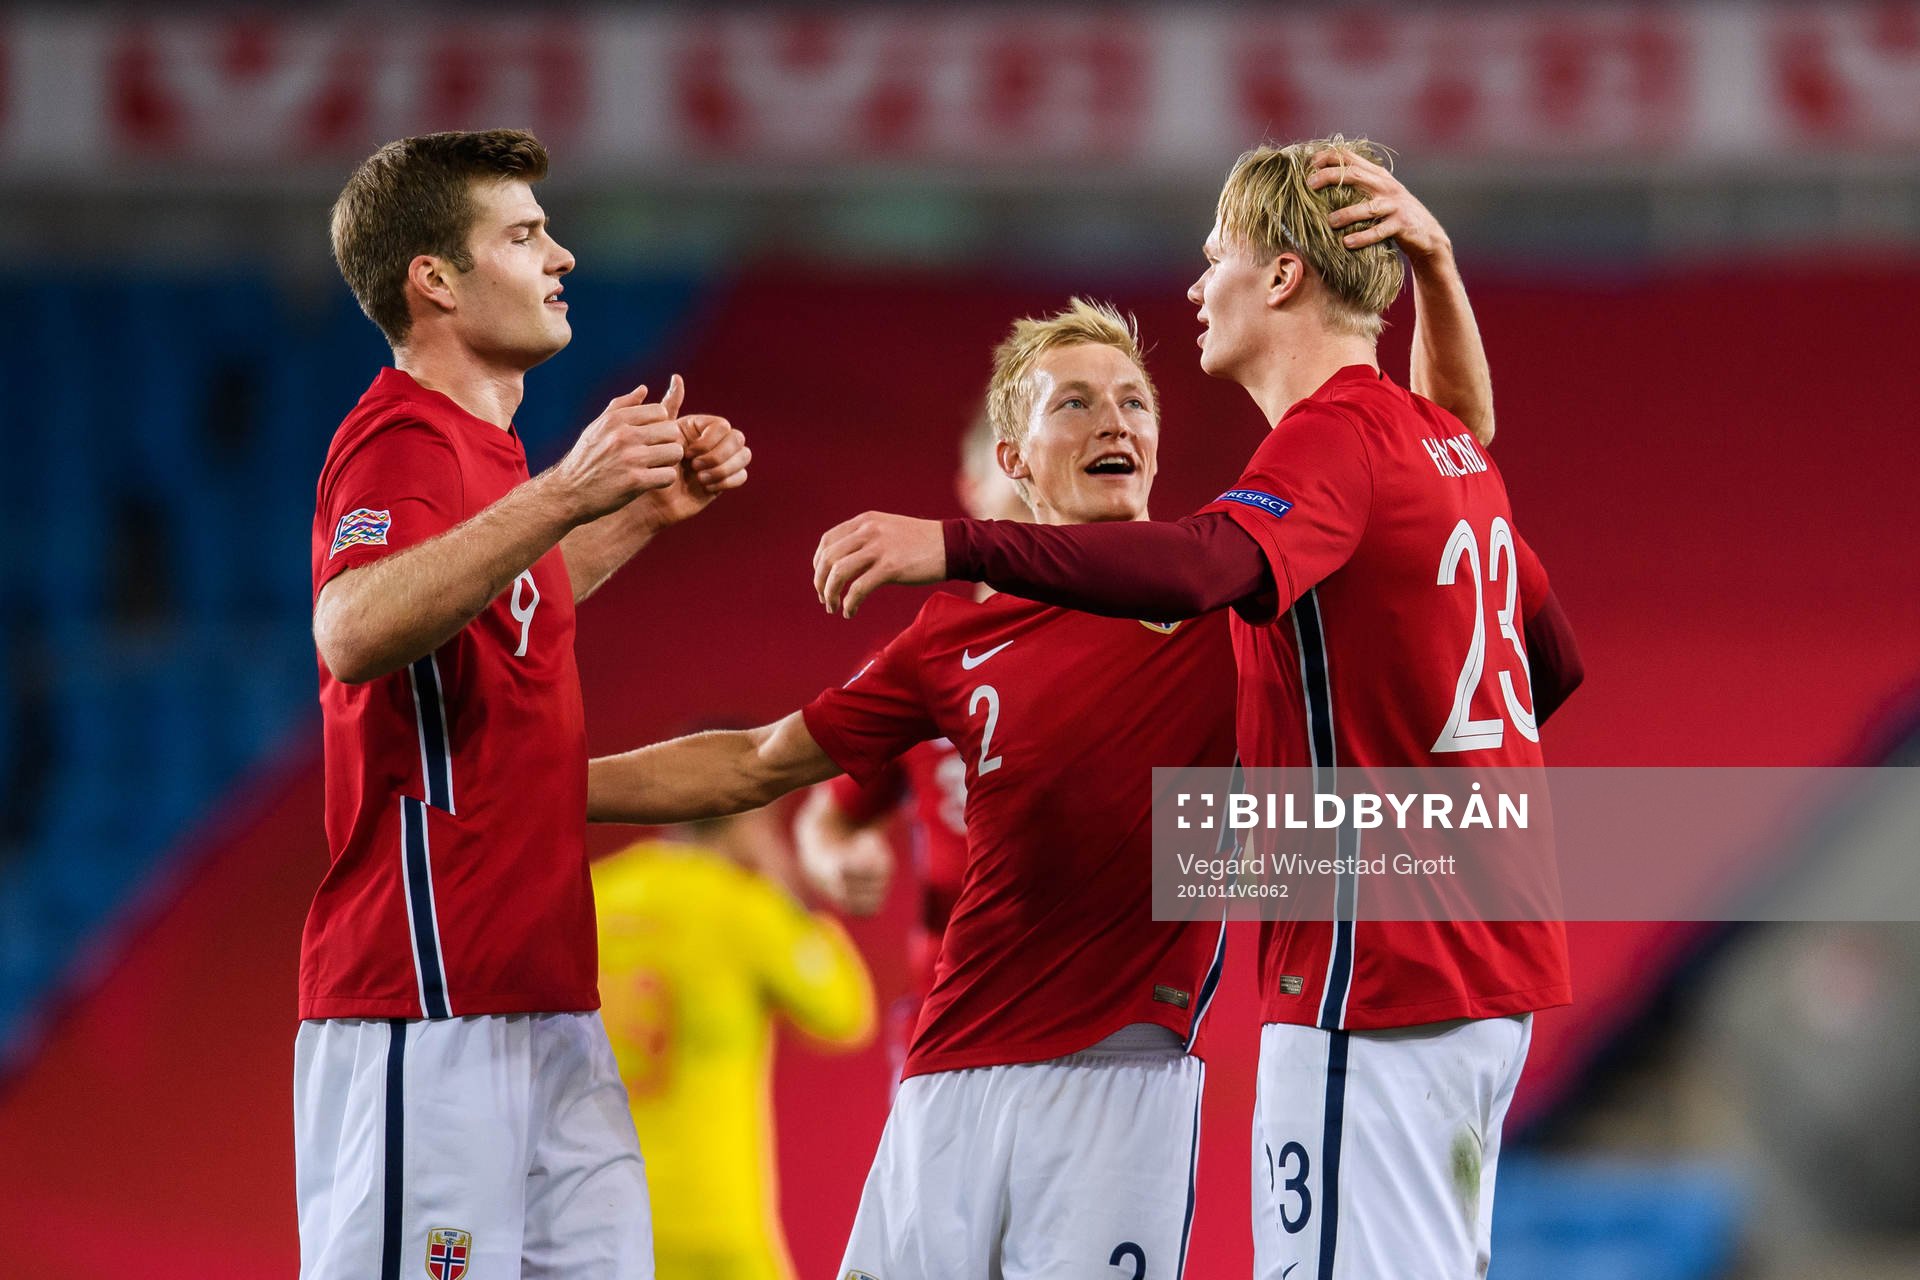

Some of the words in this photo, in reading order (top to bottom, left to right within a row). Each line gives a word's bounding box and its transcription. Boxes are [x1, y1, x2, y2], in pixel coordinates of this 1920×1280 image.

[1226, 491, 1289, 513] RESPECT
[510, 568, 541, 657] 9
[1430, 516, 1540, 753] 23
[968, 684, 1003, 777] 2
[1265, 1141, 1312, 1235] 3
